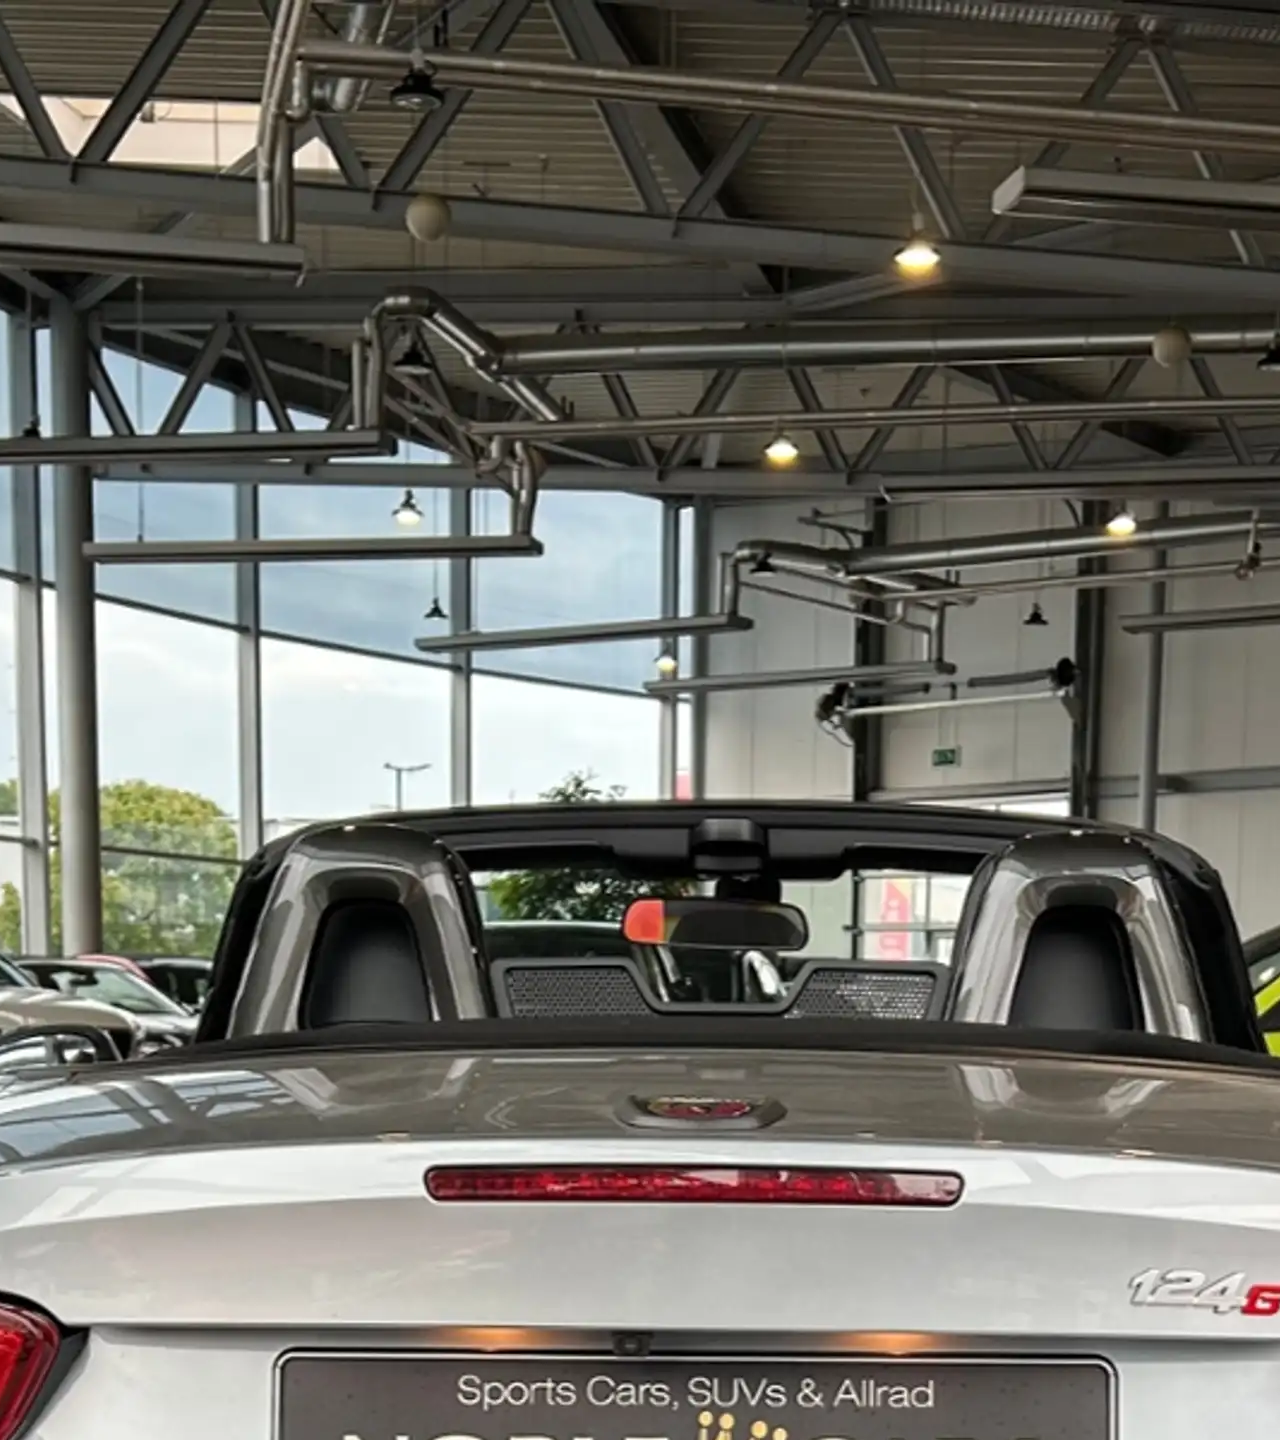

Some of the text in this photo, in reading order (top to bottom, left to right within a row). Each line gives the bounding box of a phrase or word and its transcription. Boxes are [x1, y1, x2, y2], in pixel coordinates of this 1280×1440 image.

[457, 1374, 935, 1411] Sports Cars, SUVs & Allrad
